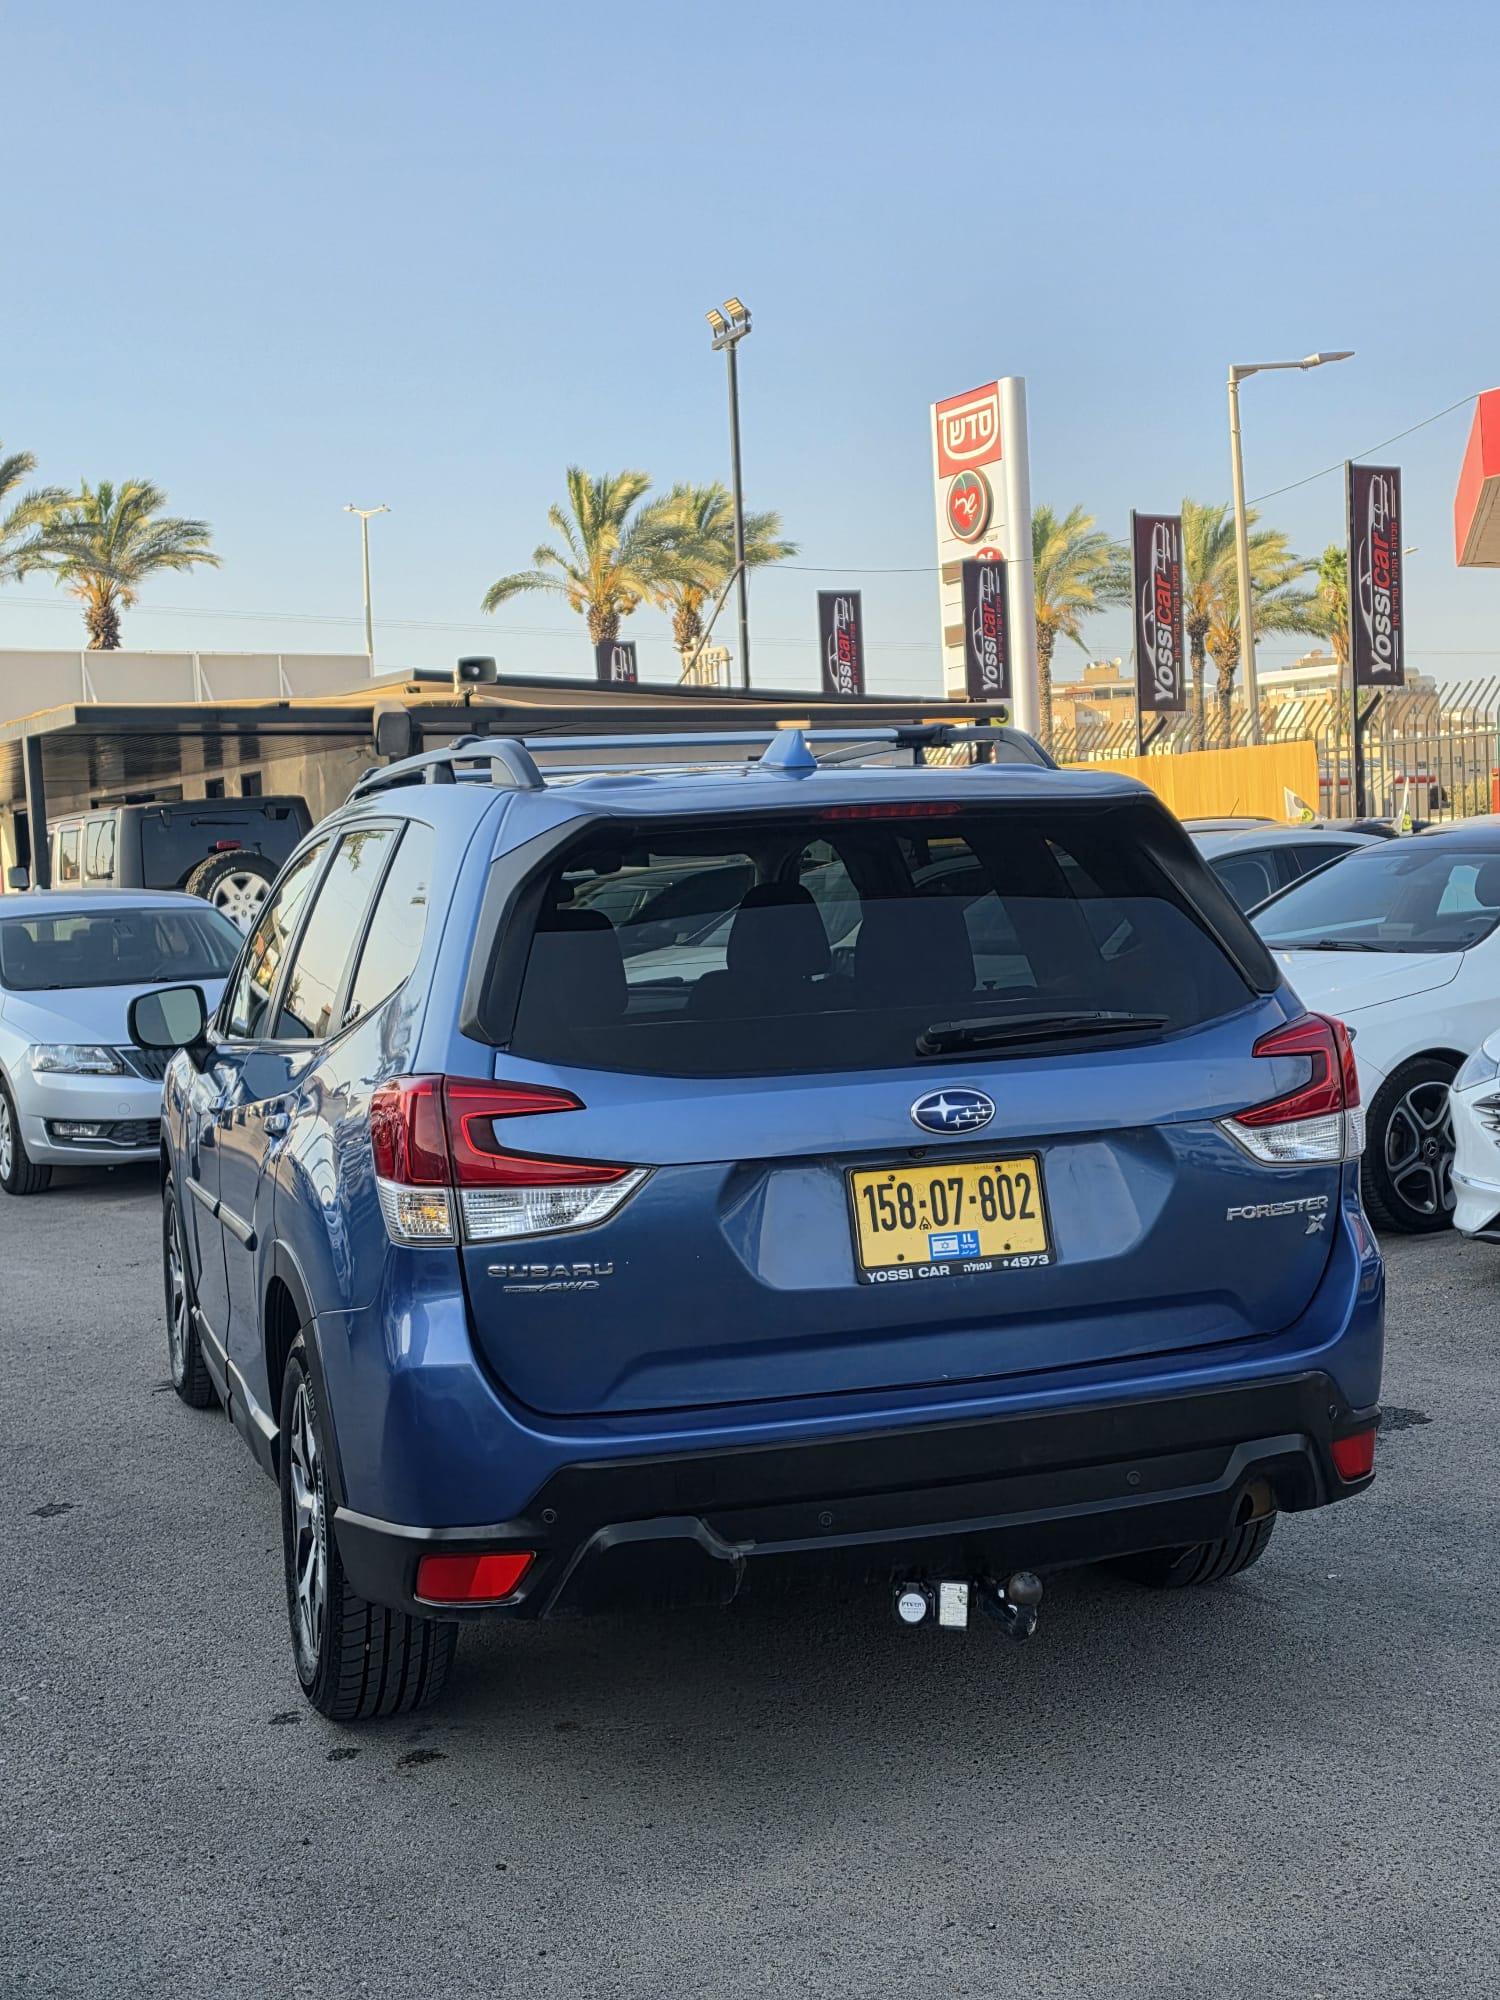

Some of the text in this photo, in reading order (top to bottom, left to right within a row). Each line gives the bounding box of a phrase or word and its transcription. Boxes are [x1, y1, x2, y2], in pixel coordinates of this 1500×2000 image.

[949, 408, 992, 447] סדש
[1226, 1195, 1329, 1221] FORESTER
[1305, 1212, 1327, 1235] X
[962, 1232, 974, 1244] IL
[487, 1262, 613, 1278] SUBARU
[866, 1265, 951, 1284] YOSSI CAR
[963, 1261, 993, 1273] עפולה
